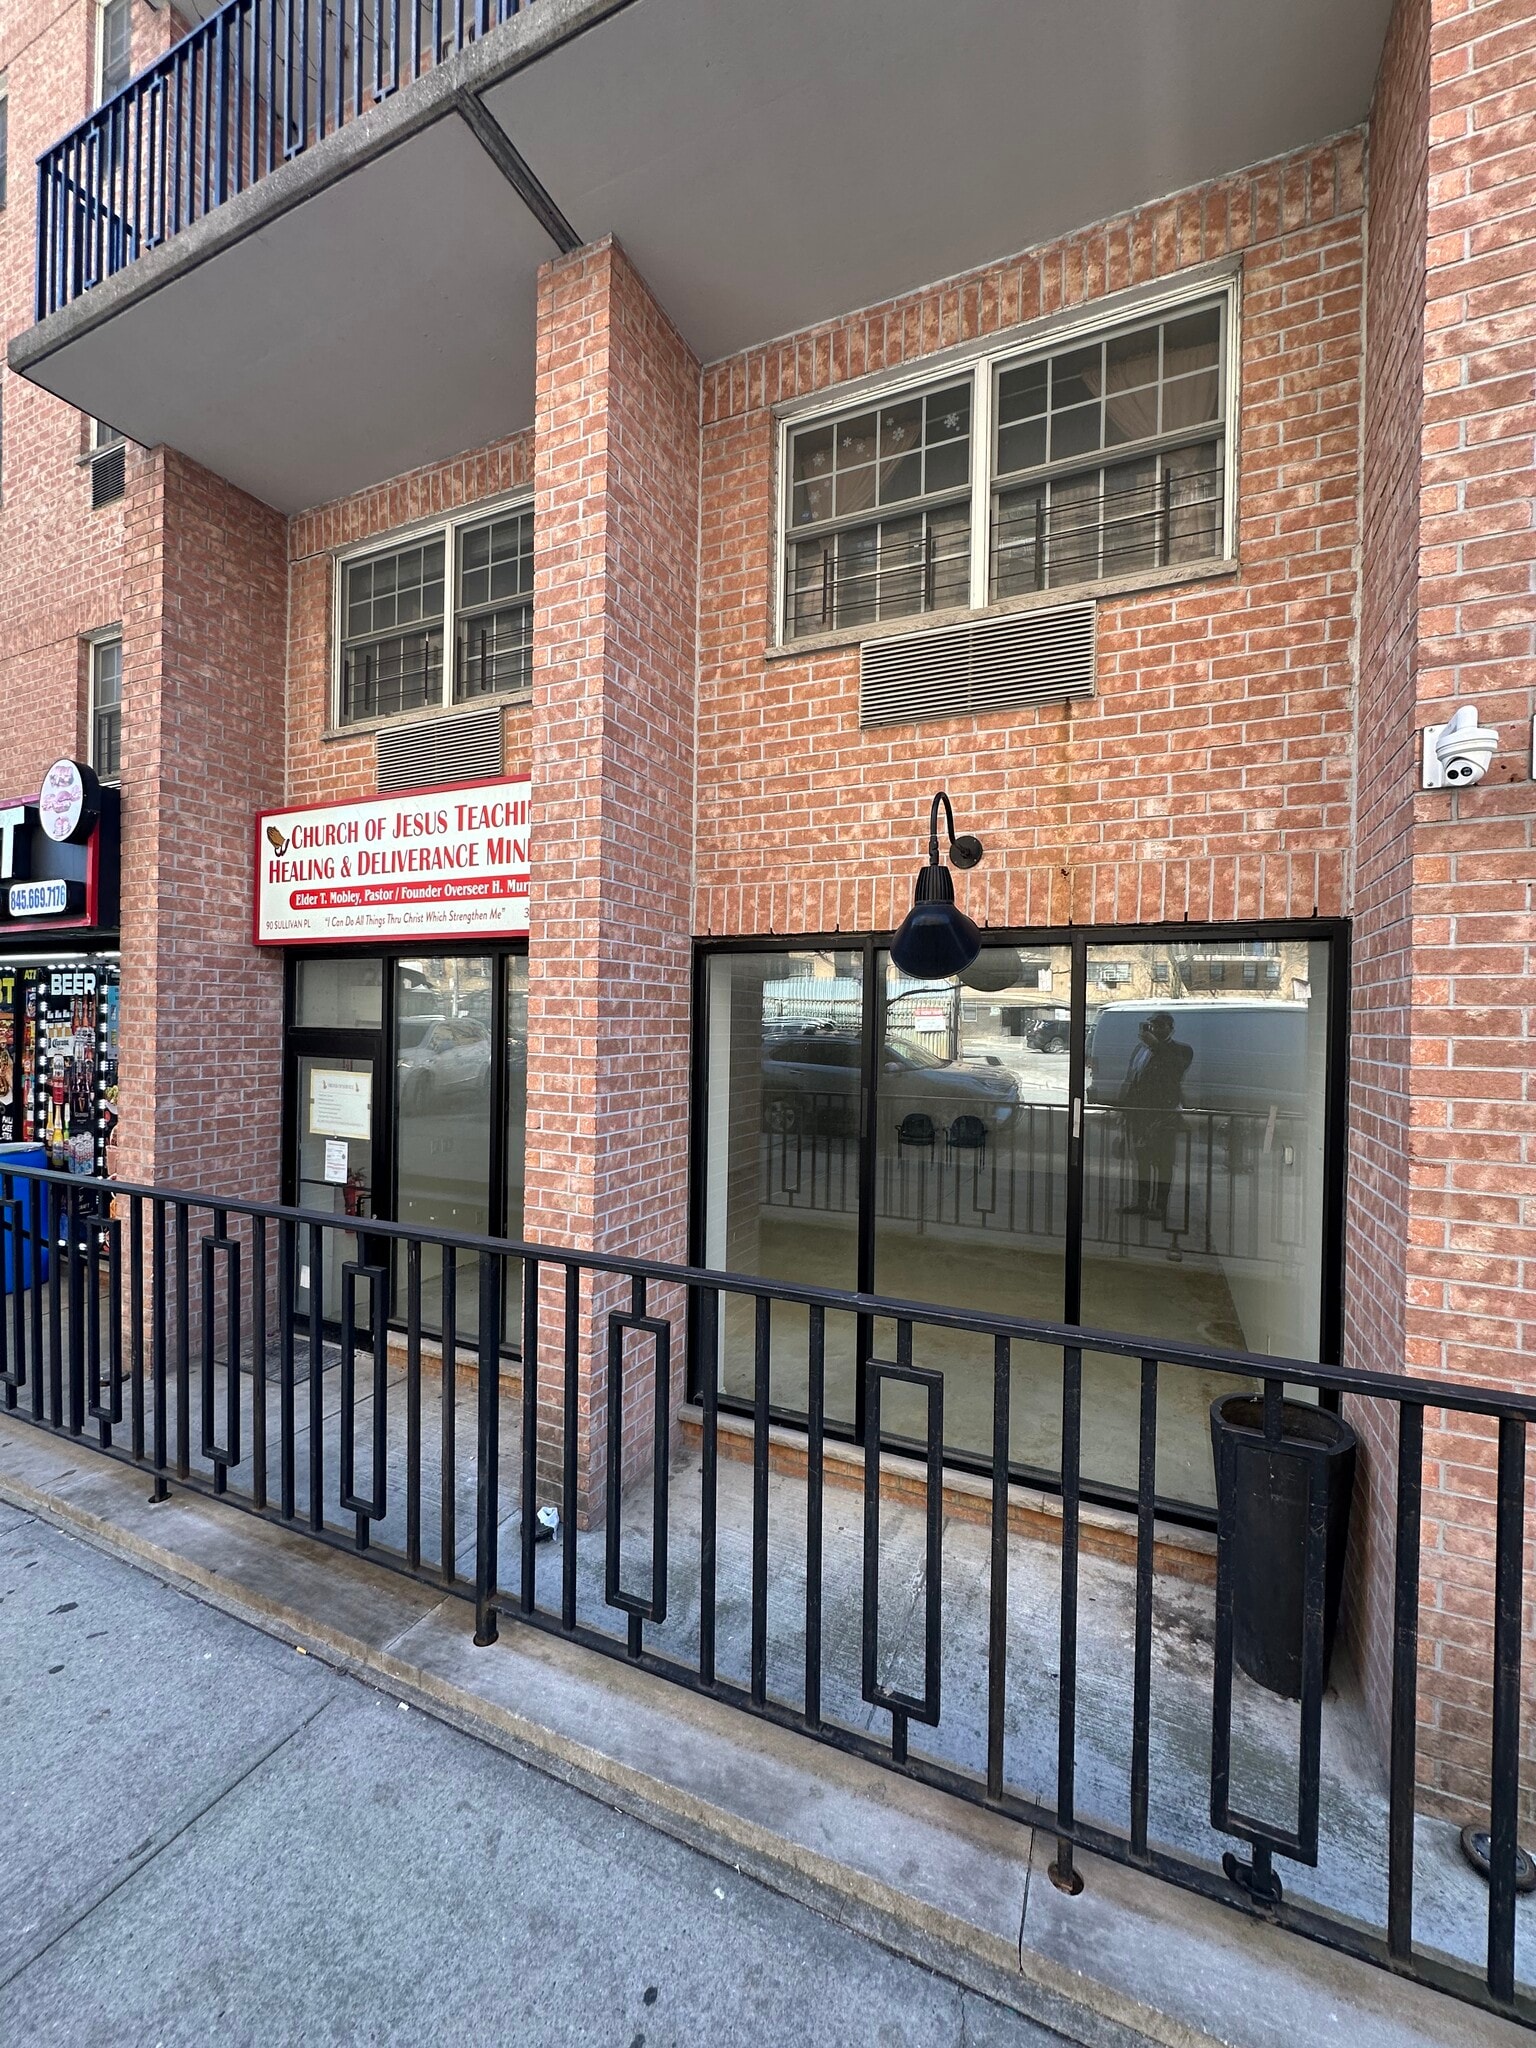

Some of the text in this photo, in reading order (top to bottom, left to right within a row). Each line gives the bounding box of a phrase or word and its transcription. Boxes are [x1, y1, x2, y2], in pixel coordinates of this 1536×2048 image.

[291, 821, 358, 850] CHURCH
[365, 817, 387, 842] OF
[392, 809, 448, 839] JESUS
[268, 857, 335, 884] HEALING
[340, 855, 352, 878] &
[357, 842, 480, 876] DELIVERANCE
[10, 884, 66, 911] 845.669.7176
[295, 893, 318, 906] Elder
[319, 892, 328, 905] T.
[330, 890, 362, 906] Mobley,
[364, 888, 394, 902] Pastor
[395, 887, 400, 901] /
[401, 884, 442, 899] Founder
[444, 882, 489, 896] Overseer
[492, 880, 503, 894] H.
[265, 919, 311, 930] 90 SULLIVAN PL
[331, 916, 344, 927] Can
[345, 916, 354, 926] Do
[355, 915, 364, 925] All
[366, 914, 385, 928] Things
[387, 912, 402, 924] Thru
[403, 911, 424, 924] Christ
[426, 910, 447, 923] Which
[449, 909, 488, 924] Strengthen
[50, 972, 97, 996] BEER
